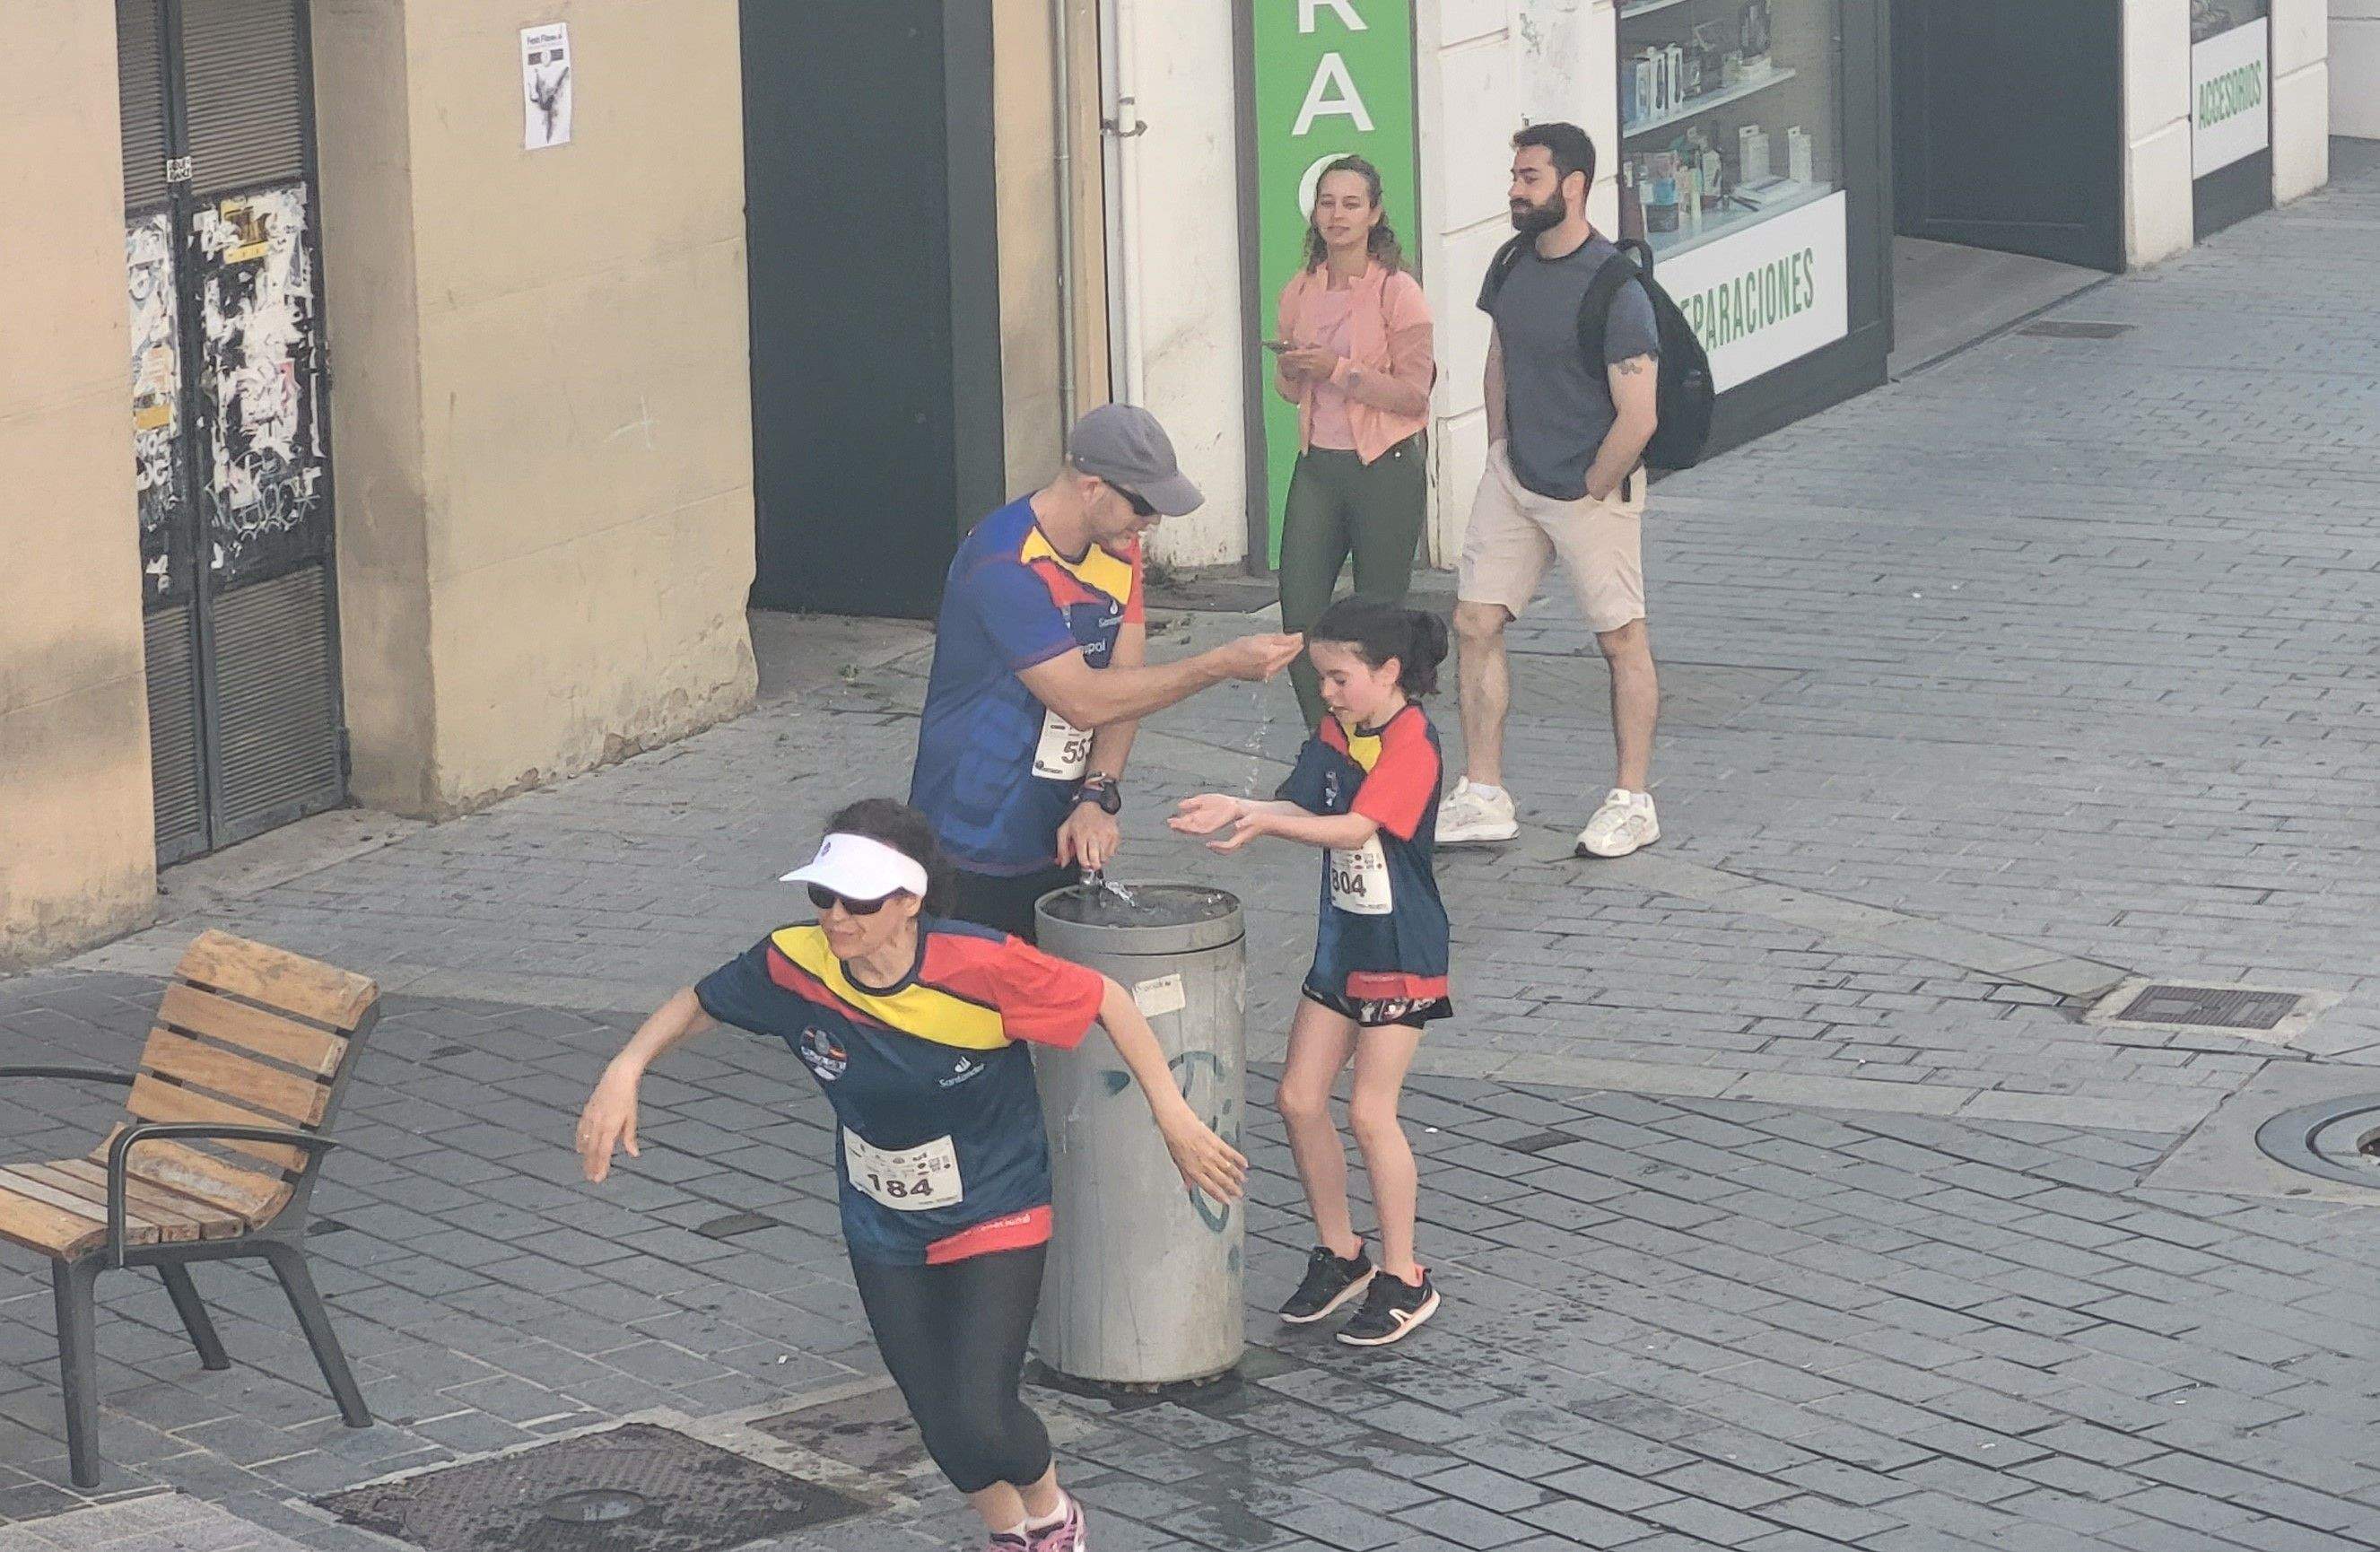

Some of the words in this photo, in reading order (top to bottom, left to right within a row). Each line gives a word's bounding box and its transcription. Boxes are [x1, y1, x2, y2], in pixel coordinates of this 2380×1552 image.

[2199, 59, 2262, 129] ACCESORIOS
[1680, 247, 1814, 352] PARACIONES
[867, 1173, 934, 1198] 184
